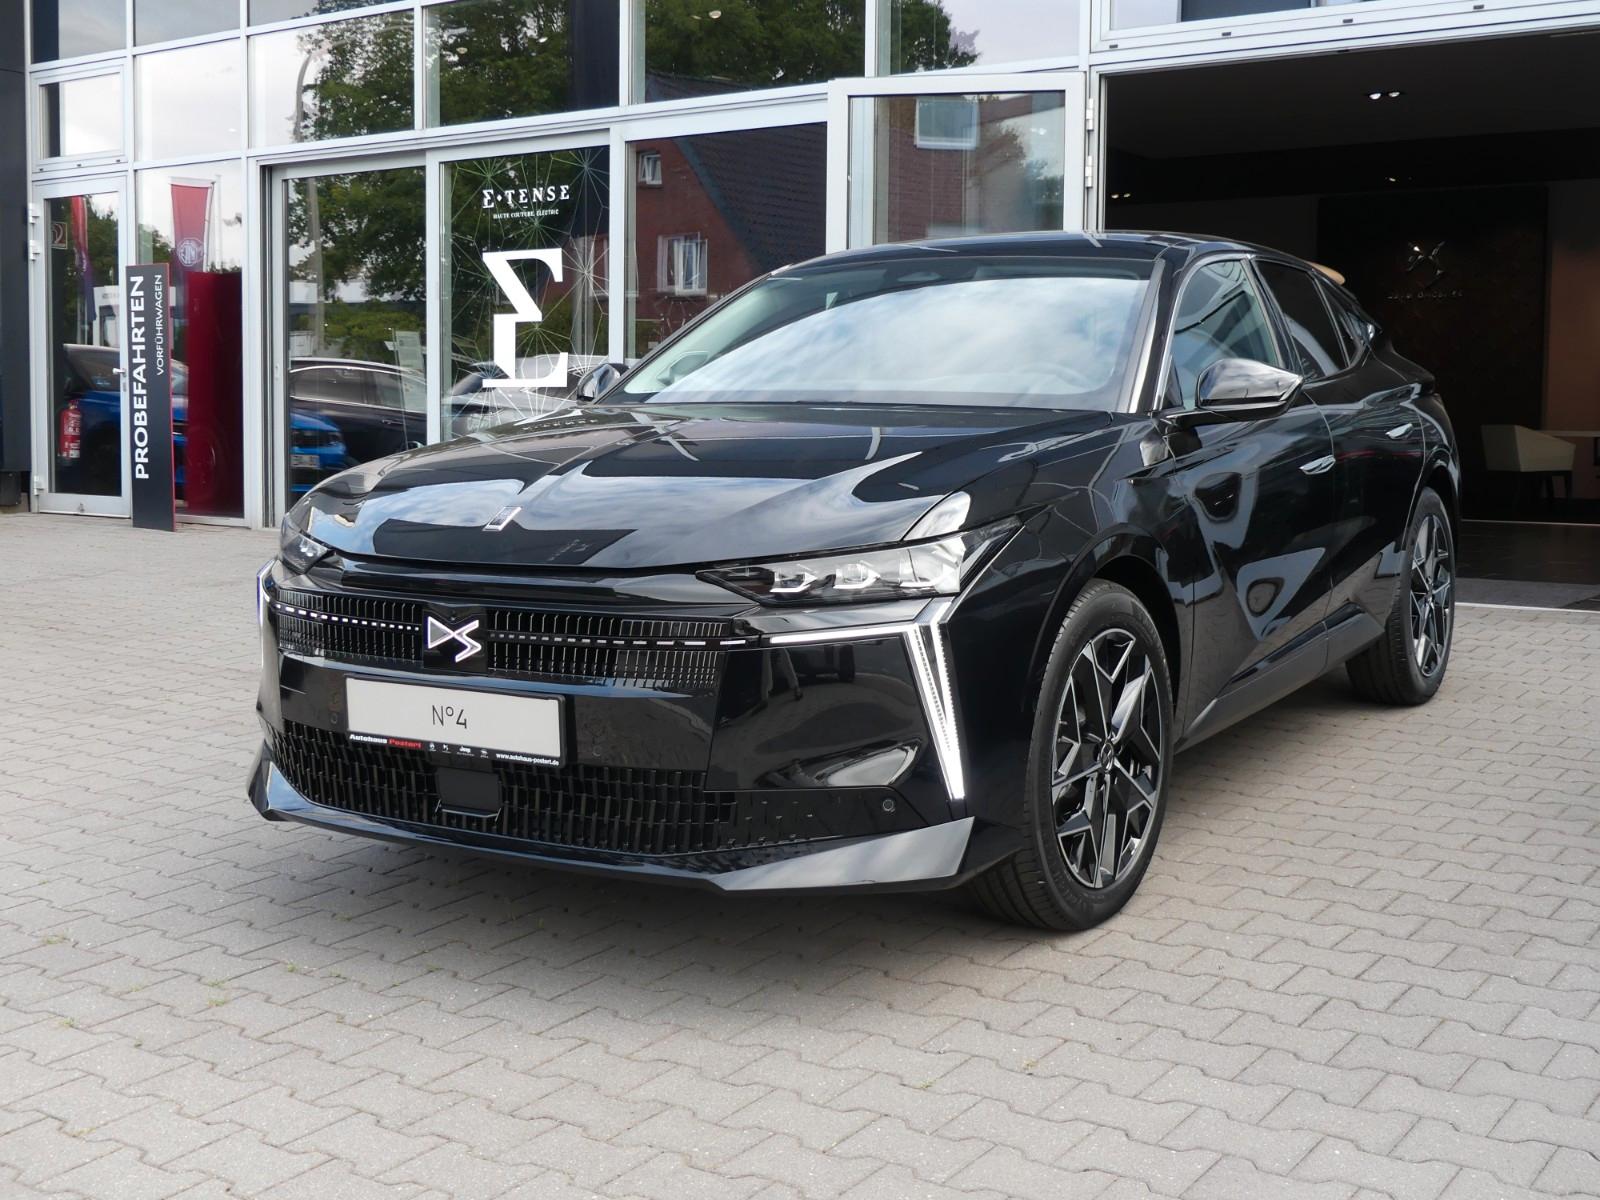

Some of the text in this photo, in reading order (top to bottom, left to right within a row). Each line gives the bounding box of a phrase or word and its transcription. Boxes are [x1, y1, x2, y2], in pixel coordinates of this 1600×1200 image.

[154, 274, 165, 376] VORFÜHRWAGEN
[131, 275, 149, 480] PROBEFAHRTEN
[349, 734, 387, 744] Autohaus
